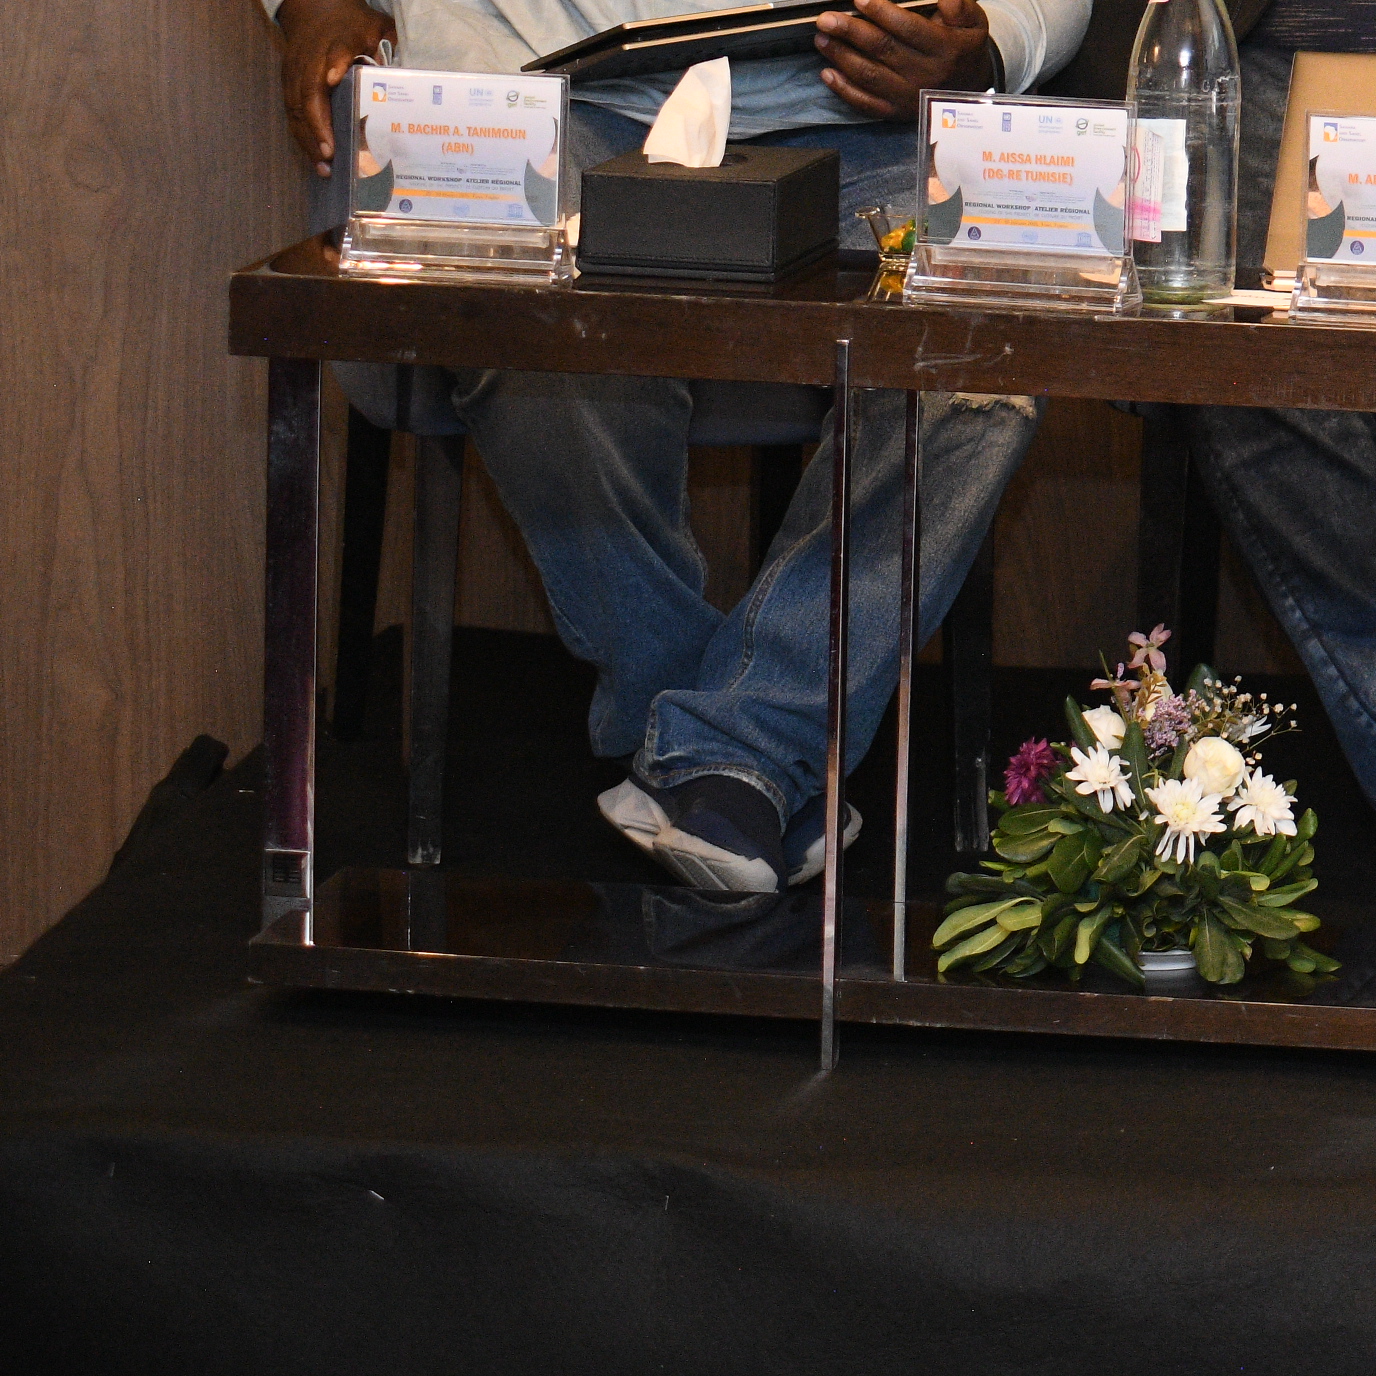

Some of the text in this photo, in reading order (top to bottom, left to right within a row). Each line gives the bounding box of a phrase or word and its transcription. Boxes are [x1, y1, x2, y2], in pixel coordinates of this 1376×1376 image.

[470, 88, 483, 96] UN
[1039, 115, 1053, 124] UN
[391, 123, 526, 139] M. BACHIR A. TANIMOUN
[442, 142, 474, 156] (ABN)
[982, 151, 1075, 167] M. AISSA HLAIMI
[983, 168, 1073, 186] (DG-RE TUNISIE)
[1348, 173, 1362, 184] M.
[964, 201, 994, 209] REGIONAL
